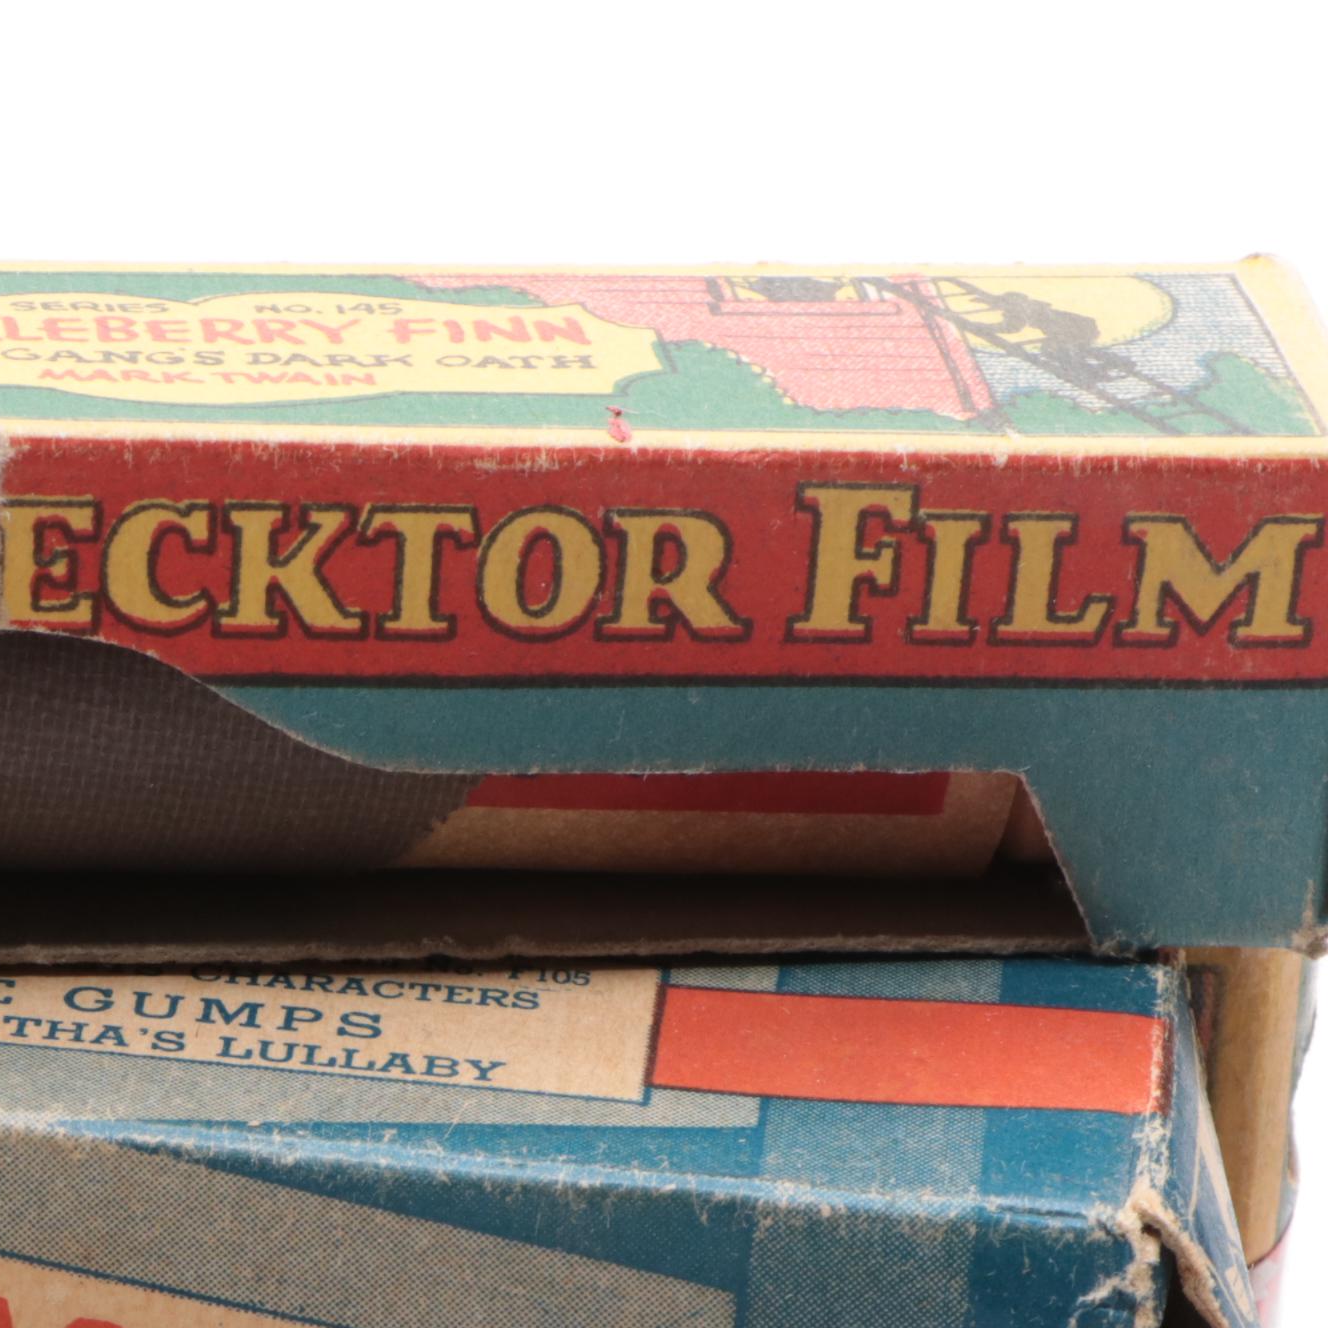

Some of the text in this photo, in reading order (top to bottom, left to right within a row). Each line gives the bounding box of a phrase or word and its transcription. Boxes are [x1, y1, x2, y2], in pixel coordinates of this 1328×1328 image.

[9, 299, 403, 316] SERIES NO. 145
[387, 315, 592, 345] FINN
[246, 351, 413, 368] DARK
[435, 353, 598, 370] OATH
[37, 368, 204, 385] MARK
[211, 371, 377, 387] TWAIN
[785, 480, 1326, 648] FILM
[62, 985, 383, 1039] GUMPS
[216, 1035, 507, 1082] LULLABY
